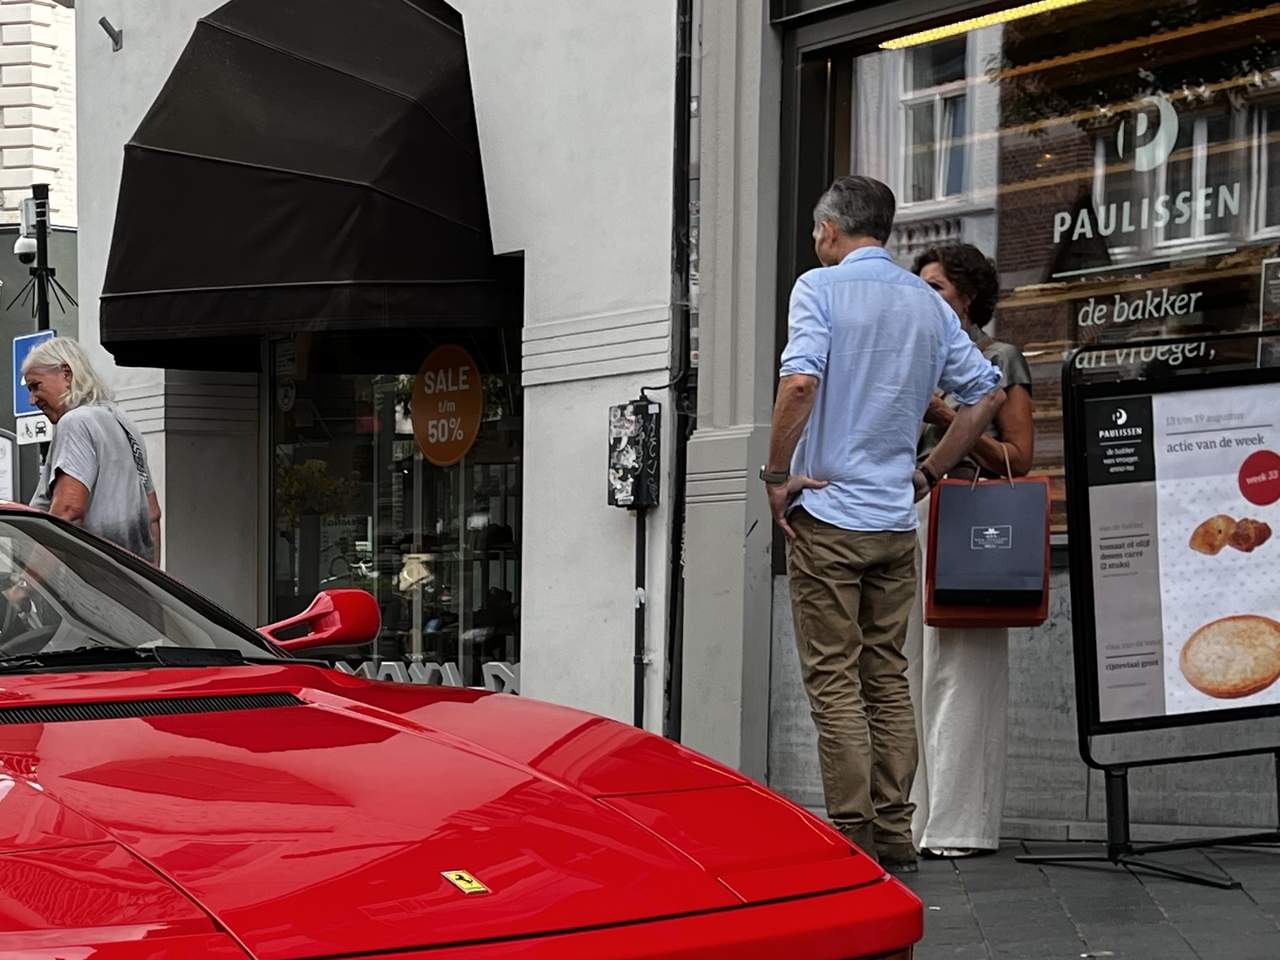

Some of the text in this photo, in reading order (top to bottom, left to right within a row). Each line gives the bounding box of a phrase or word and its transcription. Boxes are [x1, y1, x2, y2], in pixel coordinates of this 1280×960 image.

[1053, 182, 1241, 244] PAULISSEN
[1078, 288, 1203, 327] de bakker
[424, 366, 470, 395] SALE
[438, 399, 456, 413] t/m
[1205, 412, 1245, 424] augustus
[428, 417, 464, 444] 50%
[1099, 427, 1143, 439] PAULISSEN
[1166, 433, 1265, 453] actie van de week
[1245, 472, 1267, 485] week
